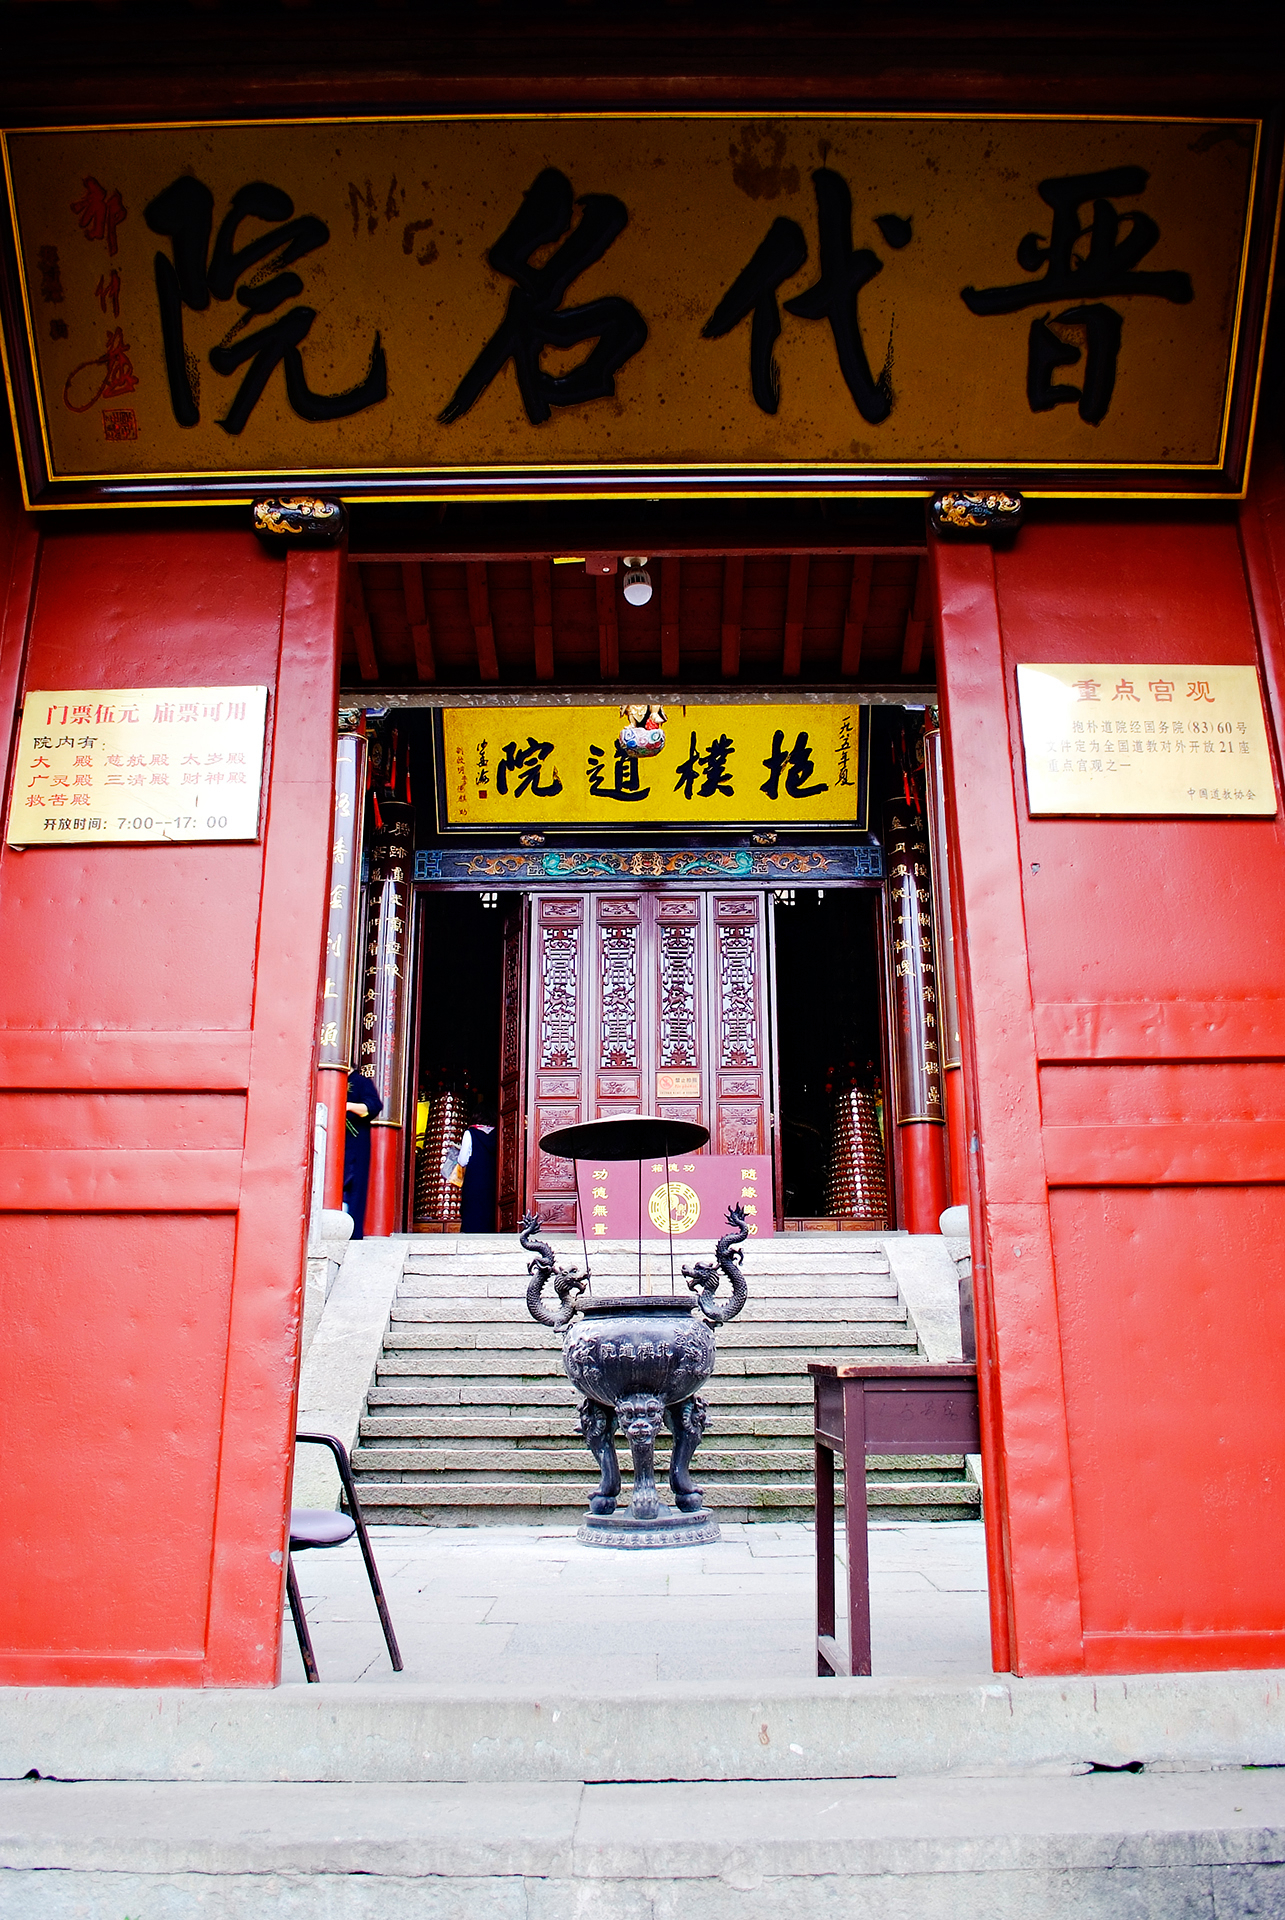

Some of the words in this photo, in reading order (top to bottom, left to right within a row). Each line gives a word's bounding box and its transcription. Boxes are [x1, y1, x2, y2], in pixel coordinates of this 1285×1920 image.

[1071, 678, 1216, 703] 重点宫观
[46, 704, 140, 725] 门票伍元
[152, 701, 247, 723] 庙票可用
[103, 753, 170, 767] 慈航殿
[180, 752, 247, 766] 太岁殿
[1048, 758, 1131, 773] 重点宫观之一
[27, 774, 94, 788] 广灵殿
[104, 772, 170, 787] 三清殿
[180, 771, 248, 786] 财神殿
[25, 793, 91, 808] 救苦殿
[1187, 786, 1256, 801] 中国道教协会
[591, 1168, 609, 1236] 功德無量
